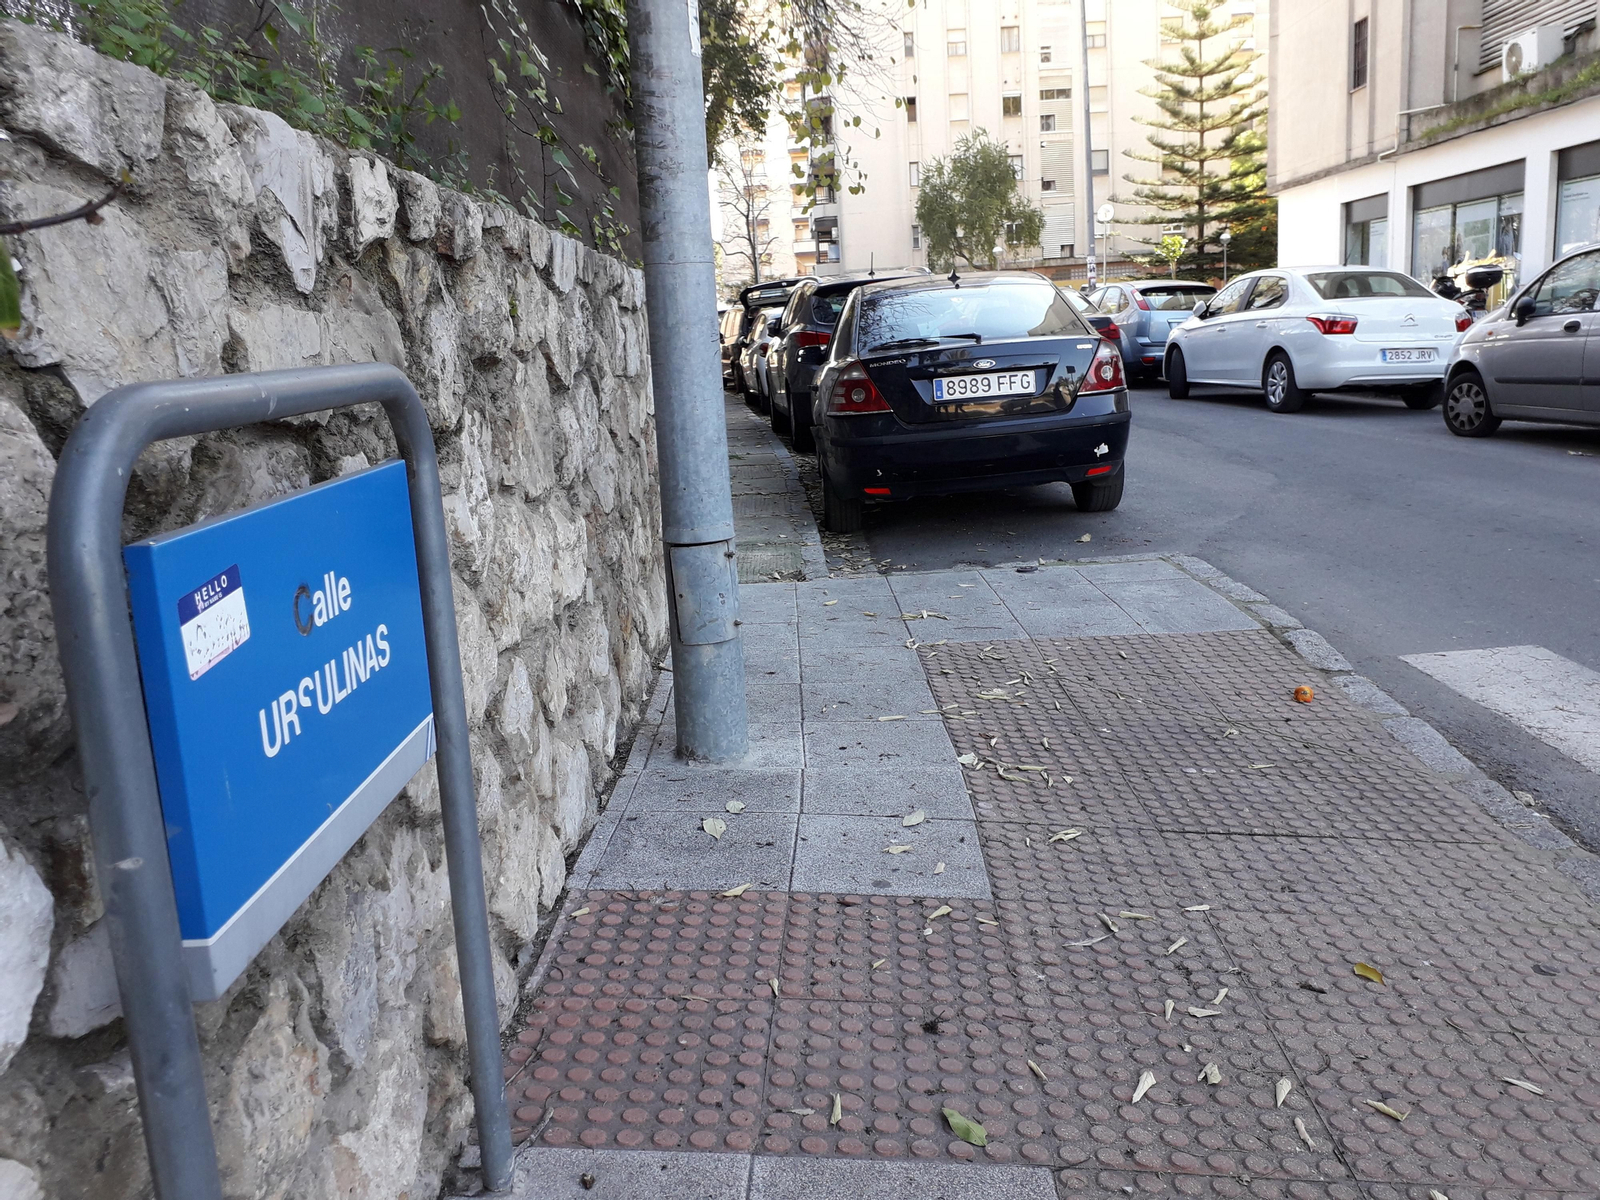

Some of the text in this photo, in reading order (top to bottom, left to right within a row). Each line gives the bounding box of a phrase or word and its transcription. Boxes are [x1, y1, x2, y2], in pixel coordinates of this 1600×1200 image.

[869, 358, 906, 368] MONDEO
[1388, 350, 1432, 361] 2852 JRV
[946, 373, 1031, 397] 8989 FFG
[194, 574, 228, 606] HELLO
